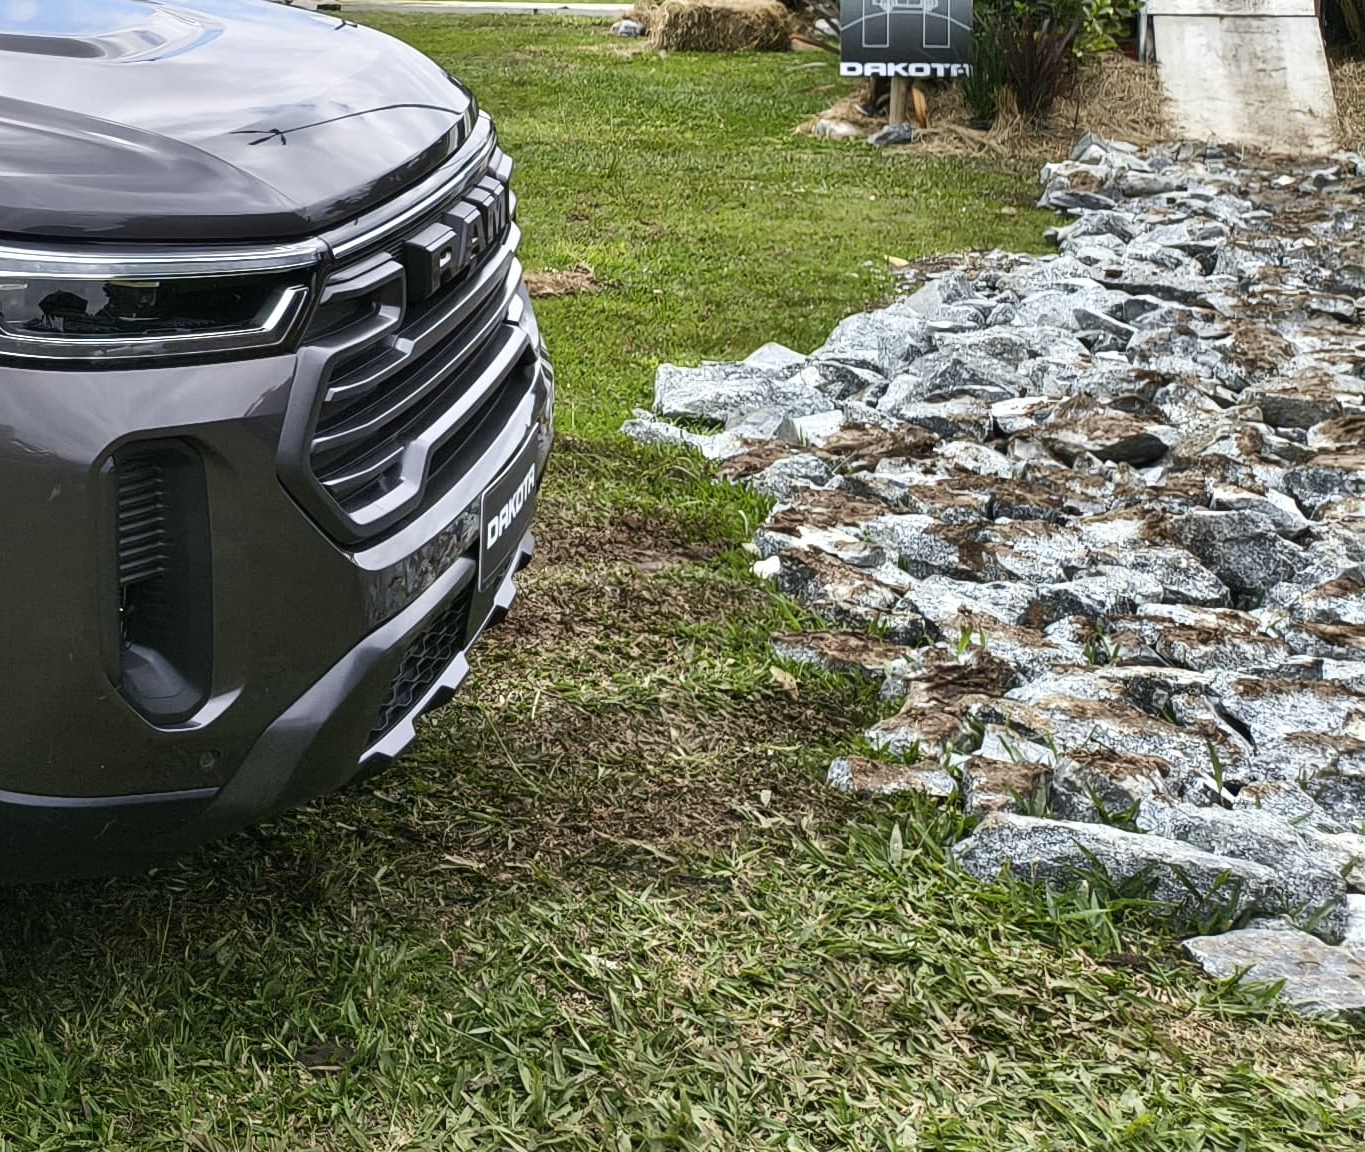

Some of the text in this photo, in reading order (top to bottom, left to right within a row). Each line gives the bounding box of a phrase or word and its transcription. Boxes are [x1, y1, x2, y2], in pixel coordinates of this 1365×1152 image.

[840, 62, 973, 78] DAKOTA
[407, 176, 508, 296] RAM
[486, 462, 536, 549] DAKOTA
